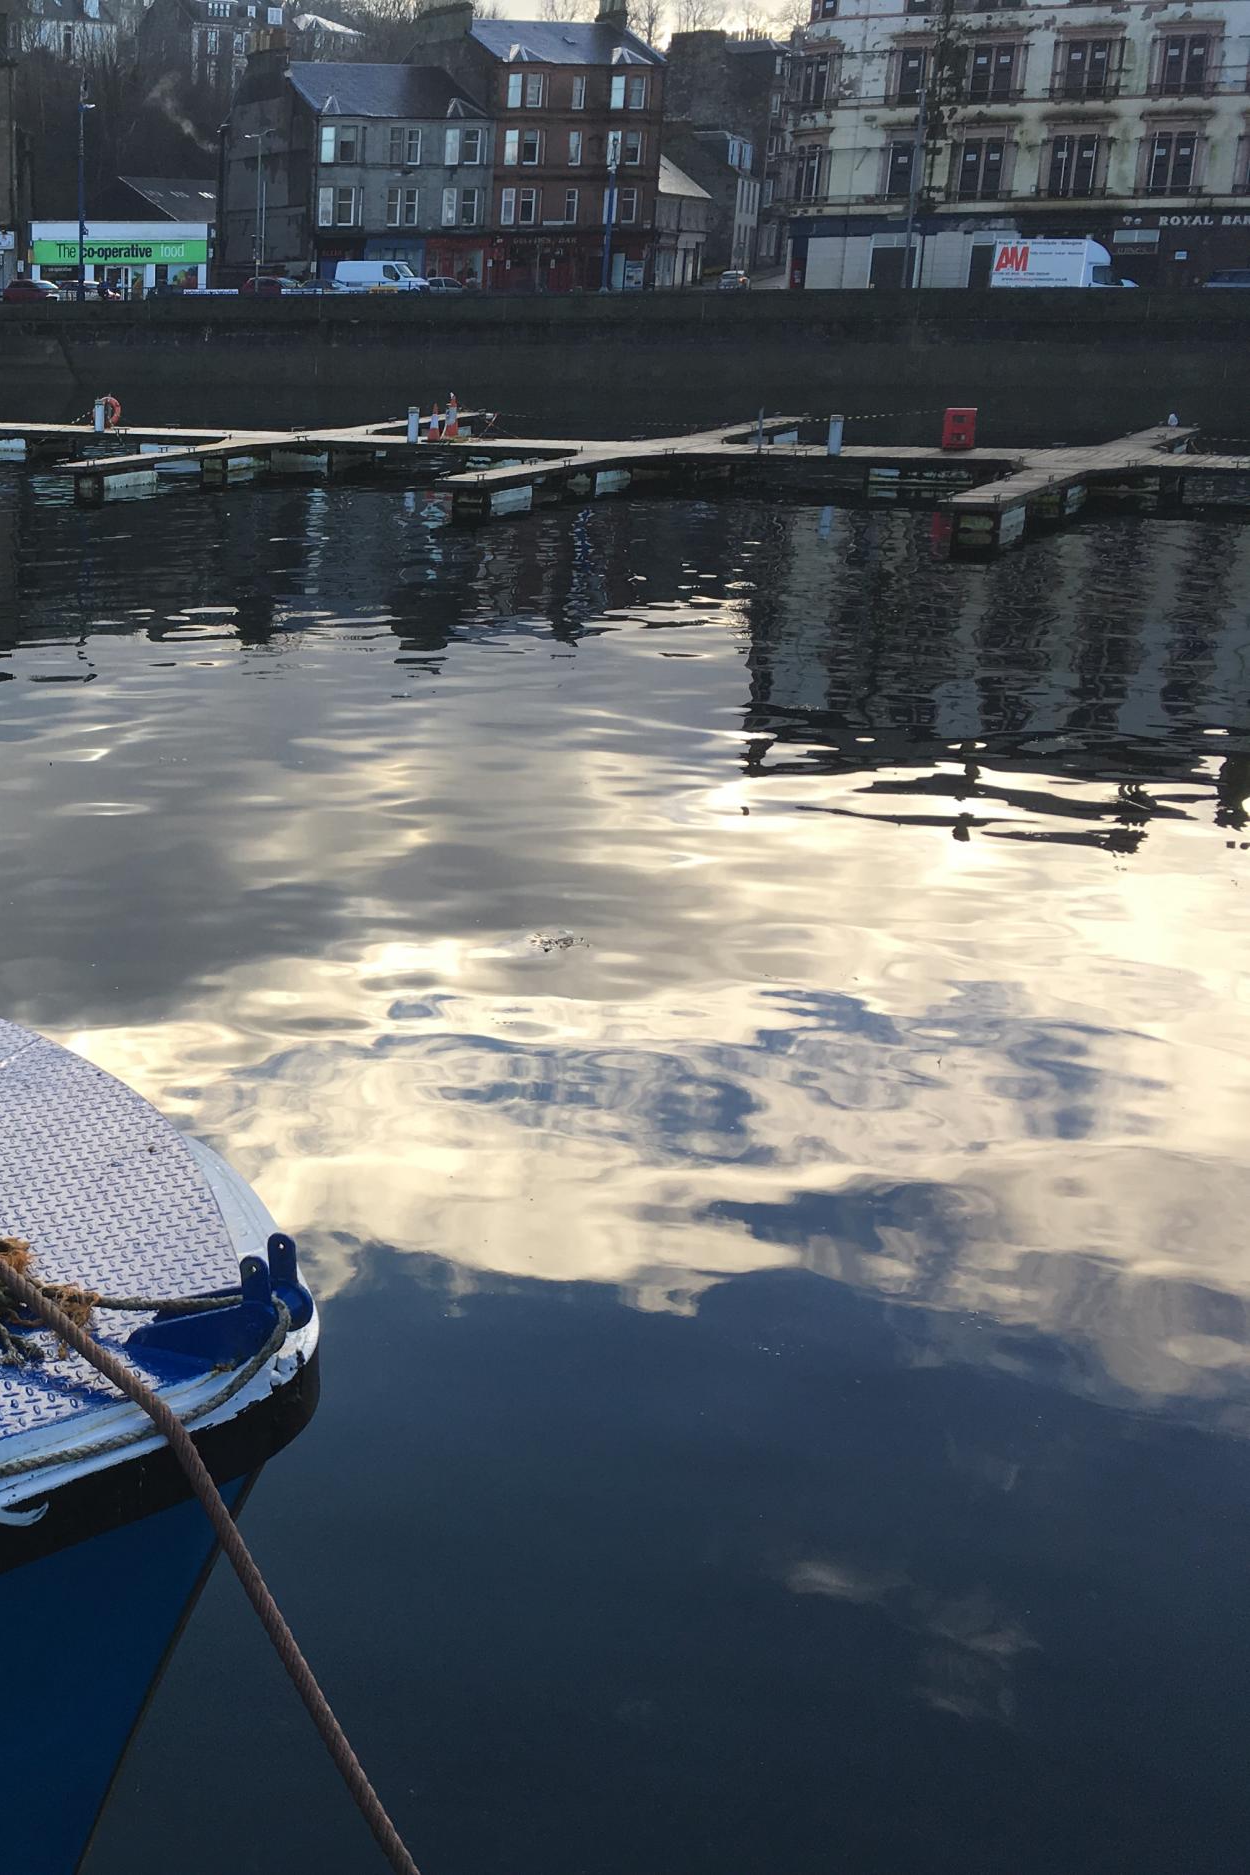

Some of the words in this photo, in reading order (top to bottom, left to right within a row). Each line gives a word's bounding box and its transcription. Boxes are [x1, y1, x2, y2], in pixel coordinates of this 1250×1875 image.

[1158, 215, 1214, 226] ROYAL
[57, 244, 76, 258] The
[81, 244, 153, 261] co-operative
[161, 244, 185, 257] food
[996, 246, 1029, 271] AM
